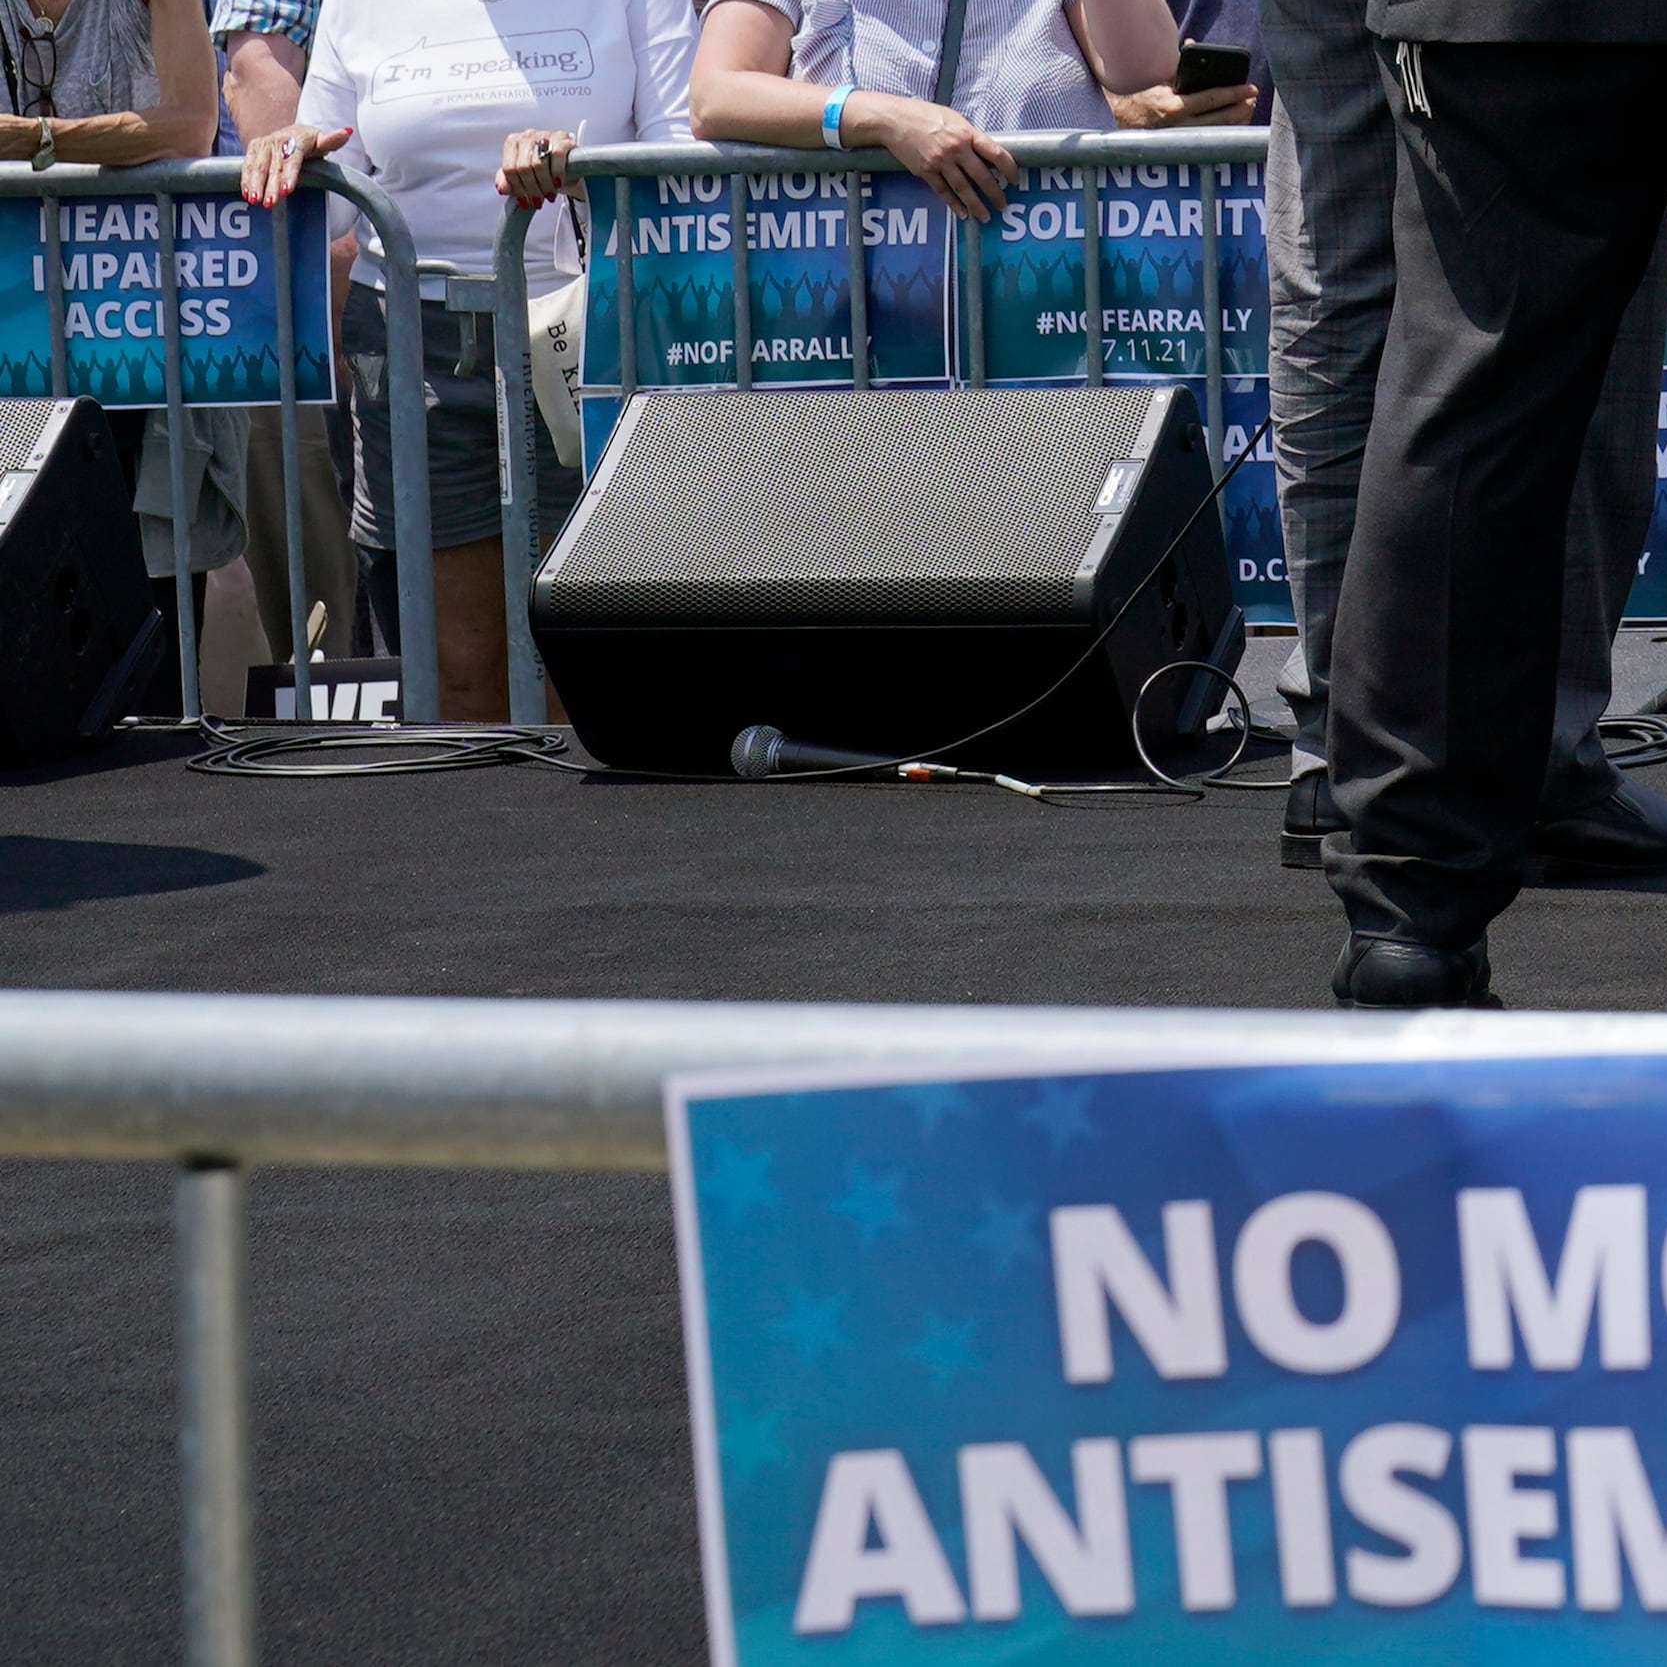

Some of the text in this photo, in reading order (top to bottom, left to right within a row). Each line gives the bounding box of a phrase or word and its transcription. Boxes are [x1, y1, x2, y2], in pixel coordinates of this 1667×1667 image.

[448, 50, 585, 81] speaking.
[658, 174, 721, 204] NO
[1101, 339, 1186, 363] 7.11.21
[1048, 1190, 1402, 1384] NO
